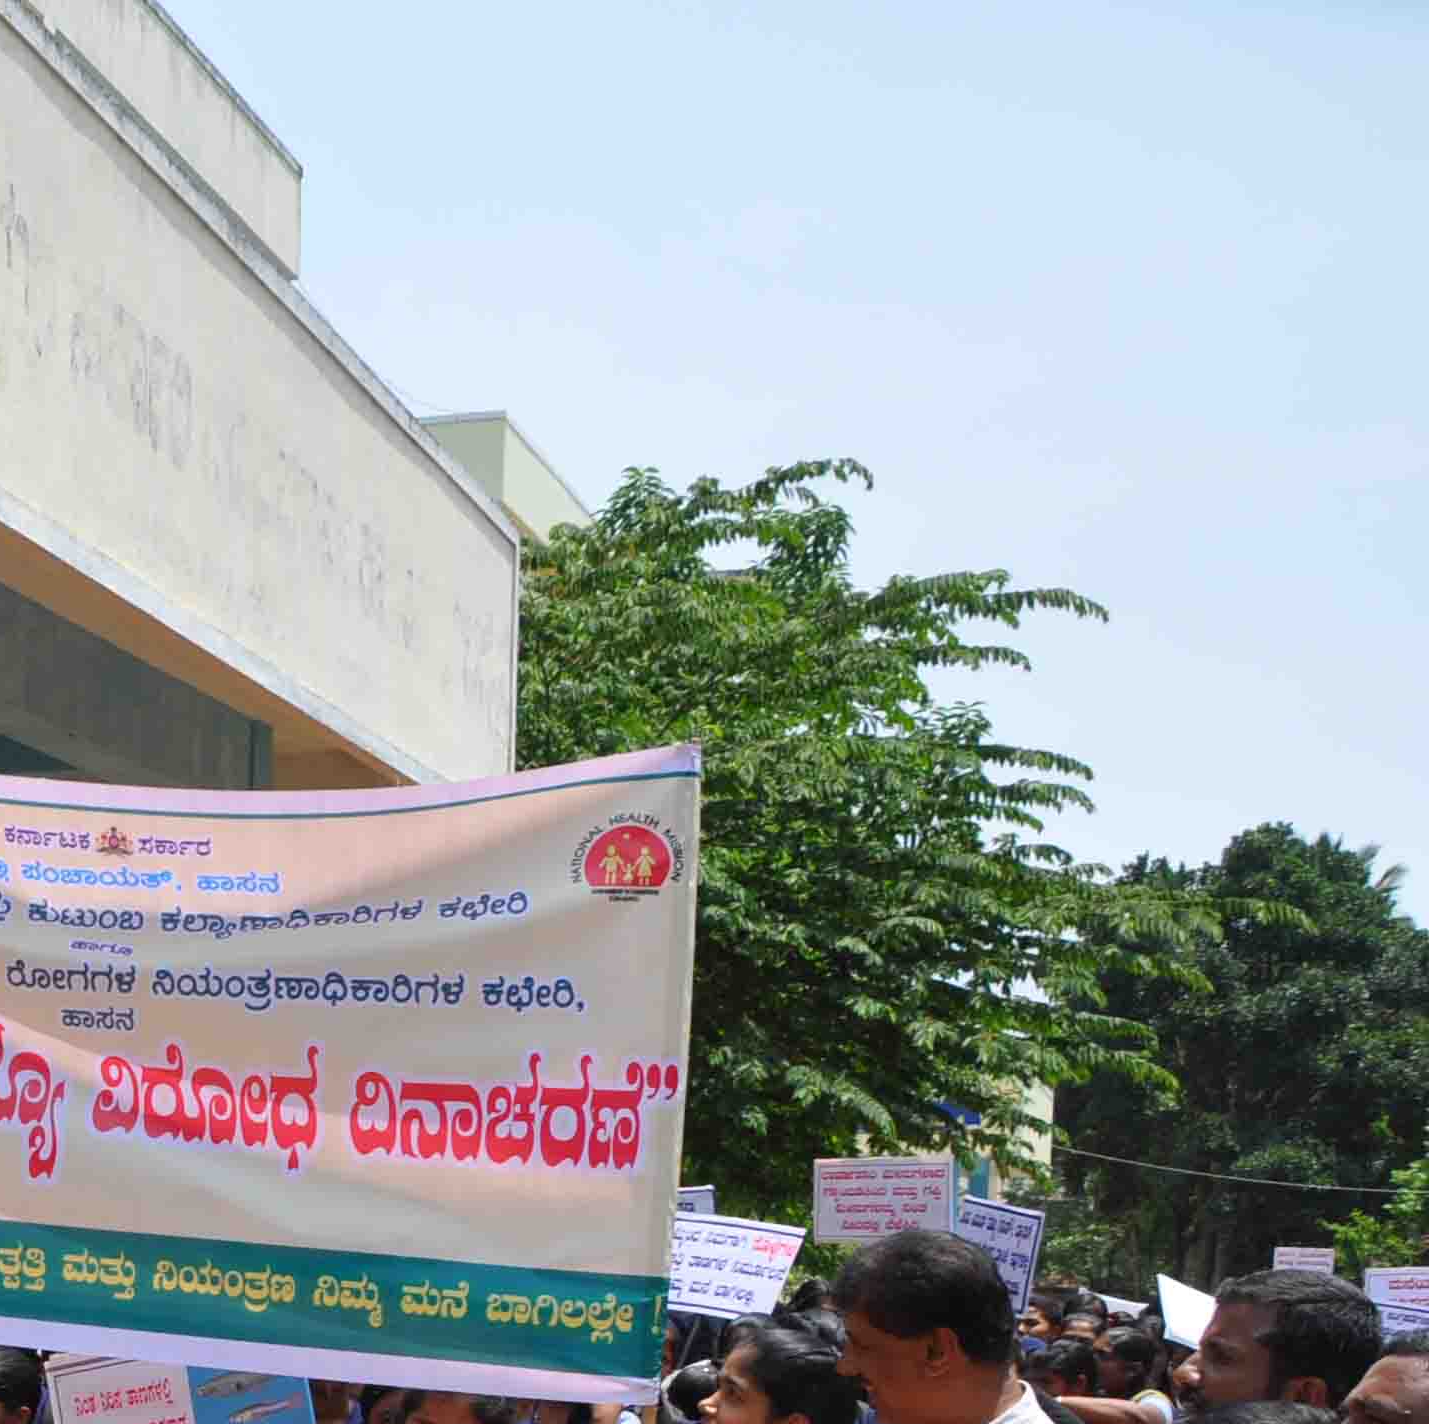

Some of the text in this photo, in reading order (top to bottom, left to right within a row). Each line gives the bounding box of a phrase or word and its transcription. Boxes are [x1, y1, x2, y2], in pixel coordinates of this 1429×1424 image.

[4, 824, 213, 857] ಕರ್ನಾಟಕ ಸರ್ಕಾರ
[571, 811, 685, 885] NATIONAL HEALTH MISSION
[196, 871, 281, 894] ಹಾಸನ
[27, 899, 146, 932] ಕುಟುಂಬ
[6, 959, 136, 995] ರೋಗಗಳ
[151, 964, 464, 1011] ನಿಯಂತ್ರಣಾಧಿಕಾರಿಗಳ
[61, 1006, 135, 1032] ಹಾಸನ
[91, 1043, 321, 1171] ವಿರೋಧ
[61, 1248, 138, 1301] ಮತ್ತು
[152, 1259, 296, 1313] ನಿಯಂತ್ರಣ
[312, 1273, 384, 1329] ನಿಮ್ಮ
[400, 1279, 470, 1320] ಮನೆ
